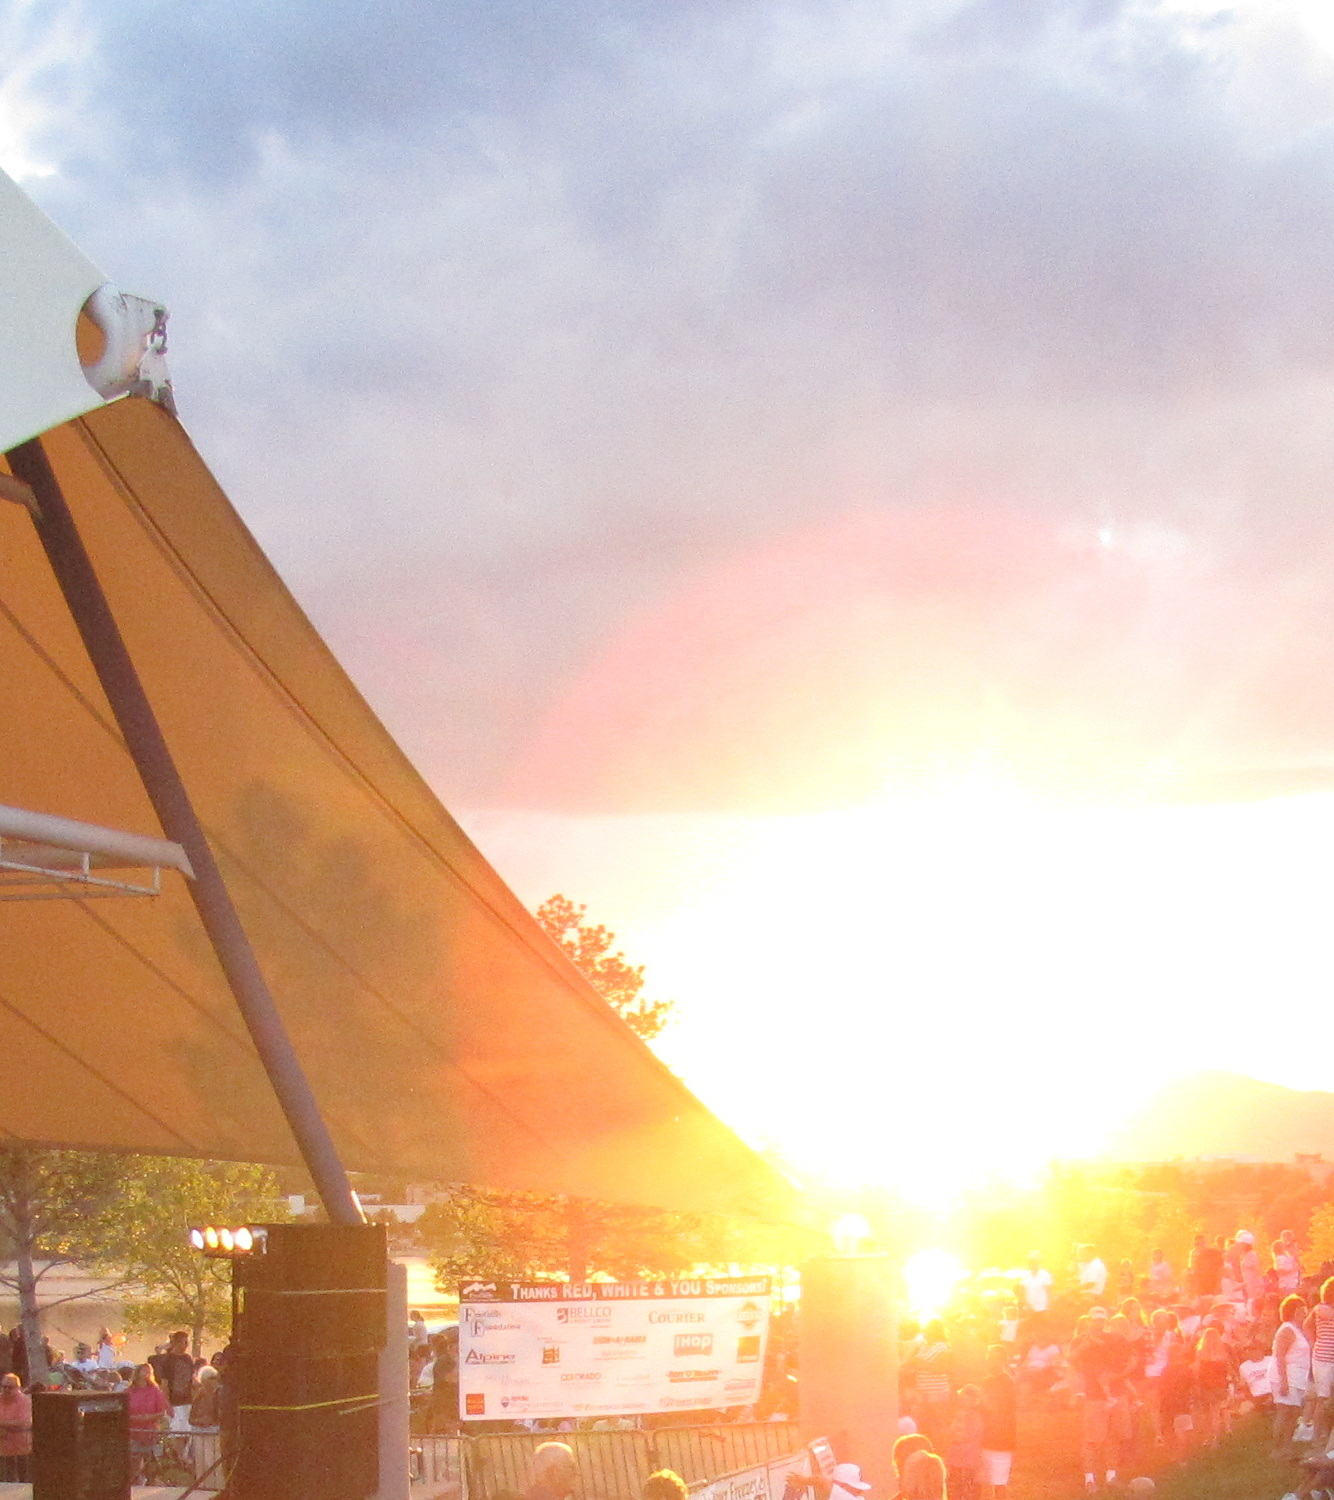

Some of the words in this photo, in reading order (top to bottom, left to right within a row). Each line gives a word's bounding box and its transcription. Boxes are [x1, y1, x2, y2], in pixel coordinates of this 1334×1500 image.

[510, 1283, 558, 1299] THANKS
[562, 1283, 597, 1300] RED,
[601, 1283, 649, 1298] WHITE
[653, 1281, 665, 1297] &
[671, 1280, 701, 1296] YOU
[706, 1277, 767, 1295] SPONSORS!
[570, 1307, 611, 1318] BELLCO
